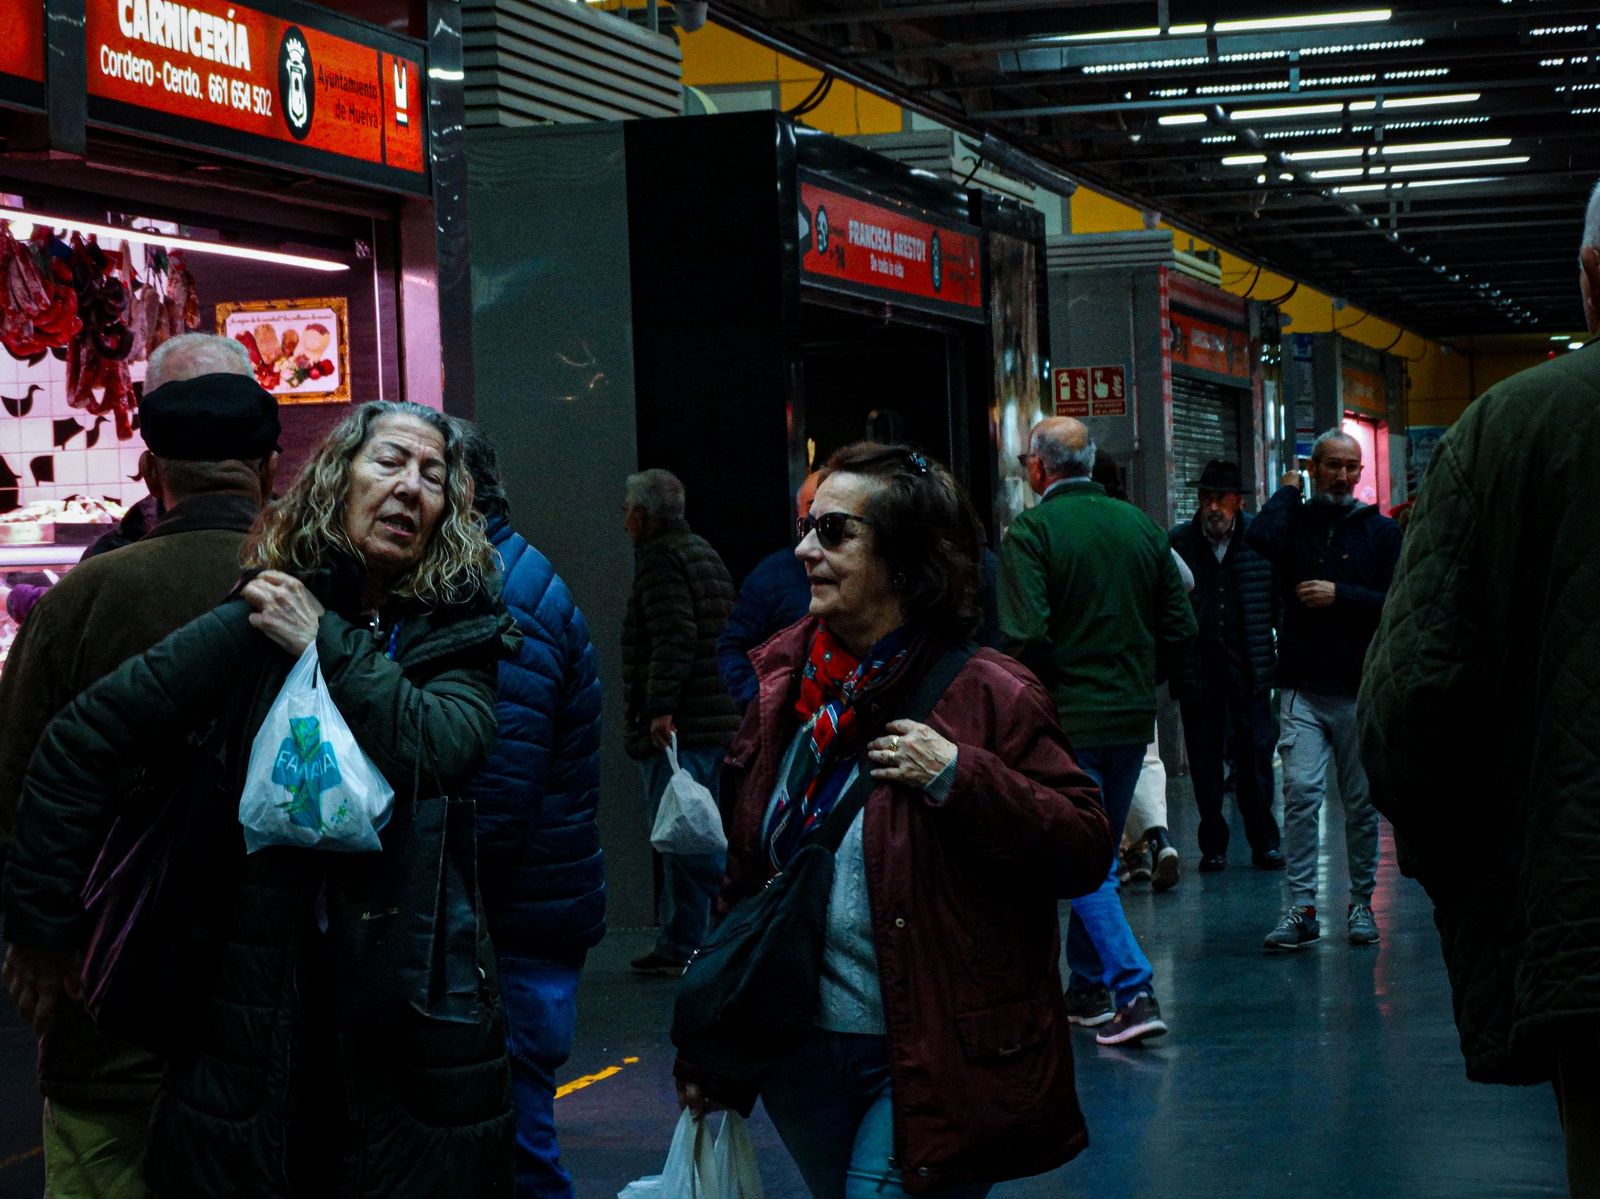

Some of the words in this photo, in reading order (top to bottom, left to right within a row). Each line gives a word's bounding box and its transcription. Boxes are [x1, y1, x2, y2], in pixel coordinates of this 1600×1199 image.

[118, 0, 250, 71] CARNICERÍA
[208, 73, 228, 105] 661
[231, 79, 251, 111] 654
[253, 86, 273, 117] 502
[319, 65, 378, 100] Ayuntamiento
[336, 101, 345, 120] de
[349, 104, 378, 128] Huelva
